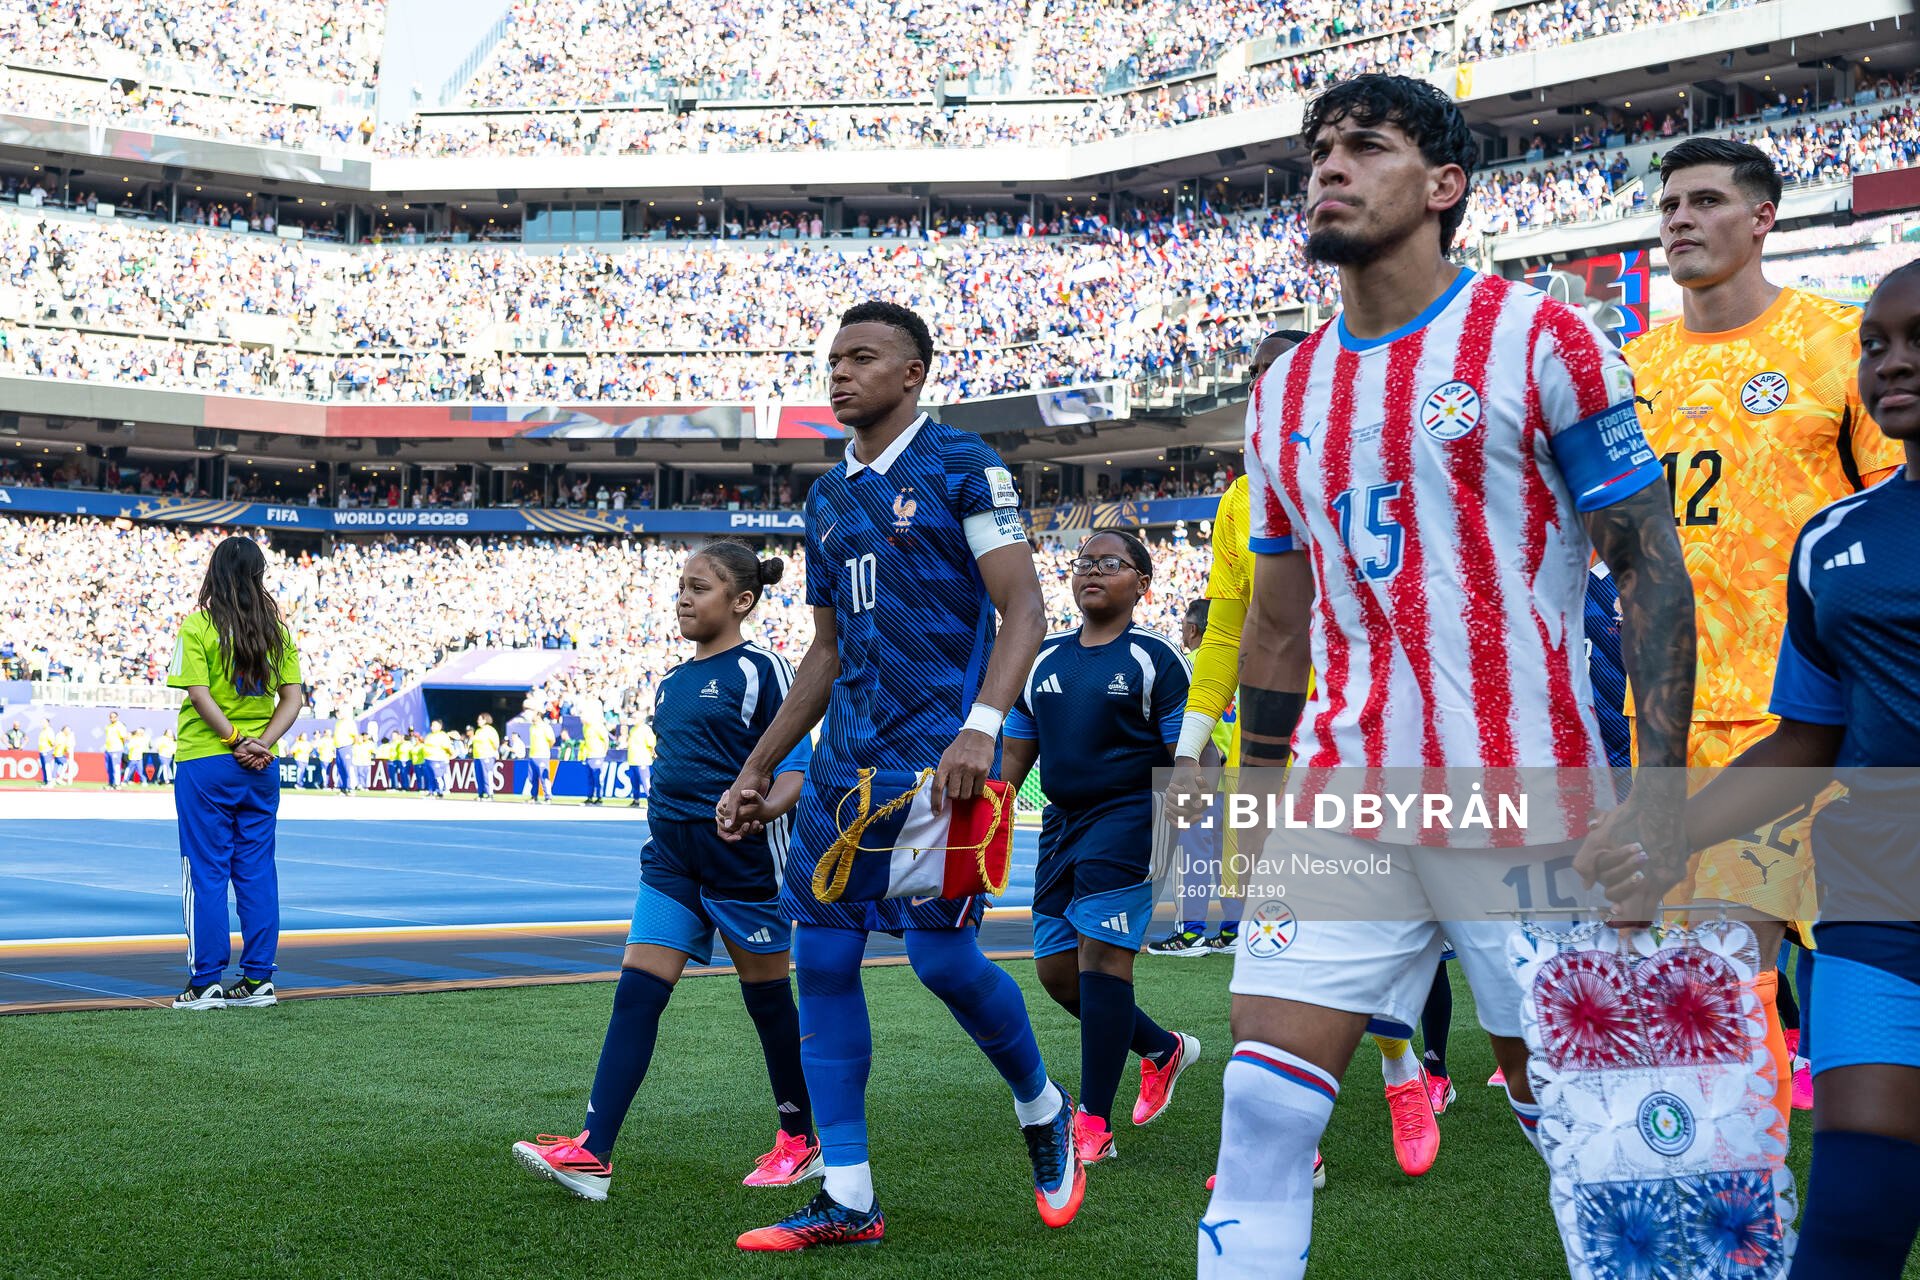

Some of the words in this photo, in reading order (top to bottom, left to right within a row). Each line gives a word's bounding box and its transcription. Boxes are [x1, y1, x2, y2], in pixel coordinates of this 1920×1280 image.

[1760, 375, 1777, 383] APF
[1659, 450, 1722, 526] 12
[267, 508, 299, 523] FIFA
[334, 511, 385, 525] WORLD
[387, 513, 416, 526] CUP
[418, 513, 469, 526] 2026
[730, 514, 805, 528] PHILA
[1331, 481, 1405, 582] 15
[845, 553, 877, 614] 10
